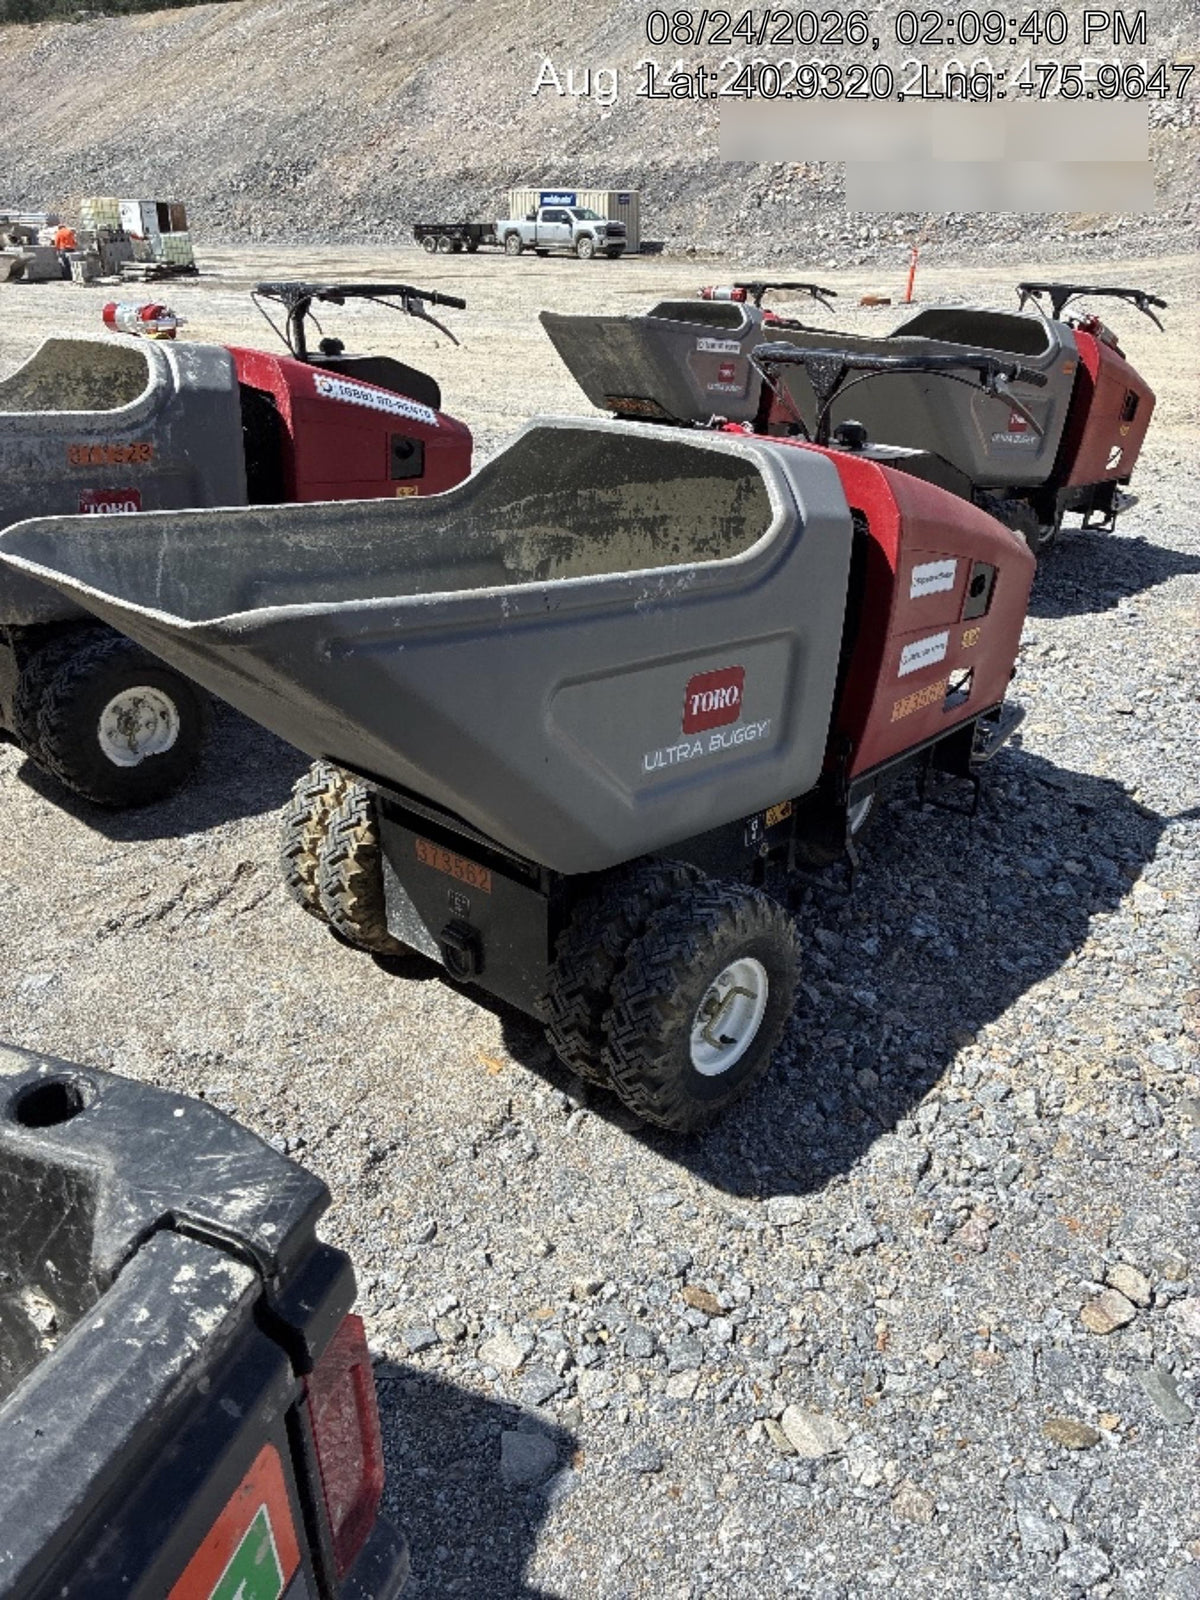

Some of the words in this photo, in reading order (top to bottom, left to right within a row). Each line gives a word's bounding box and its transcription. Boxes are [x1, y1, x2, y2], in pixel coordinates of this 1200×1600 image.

[84, 501, 138, 514] TORO
[690, 685, 741, 716] TORO
[643, 740, 704, 772] ULTRA
[709, 720, 770, 751] BUGGY
